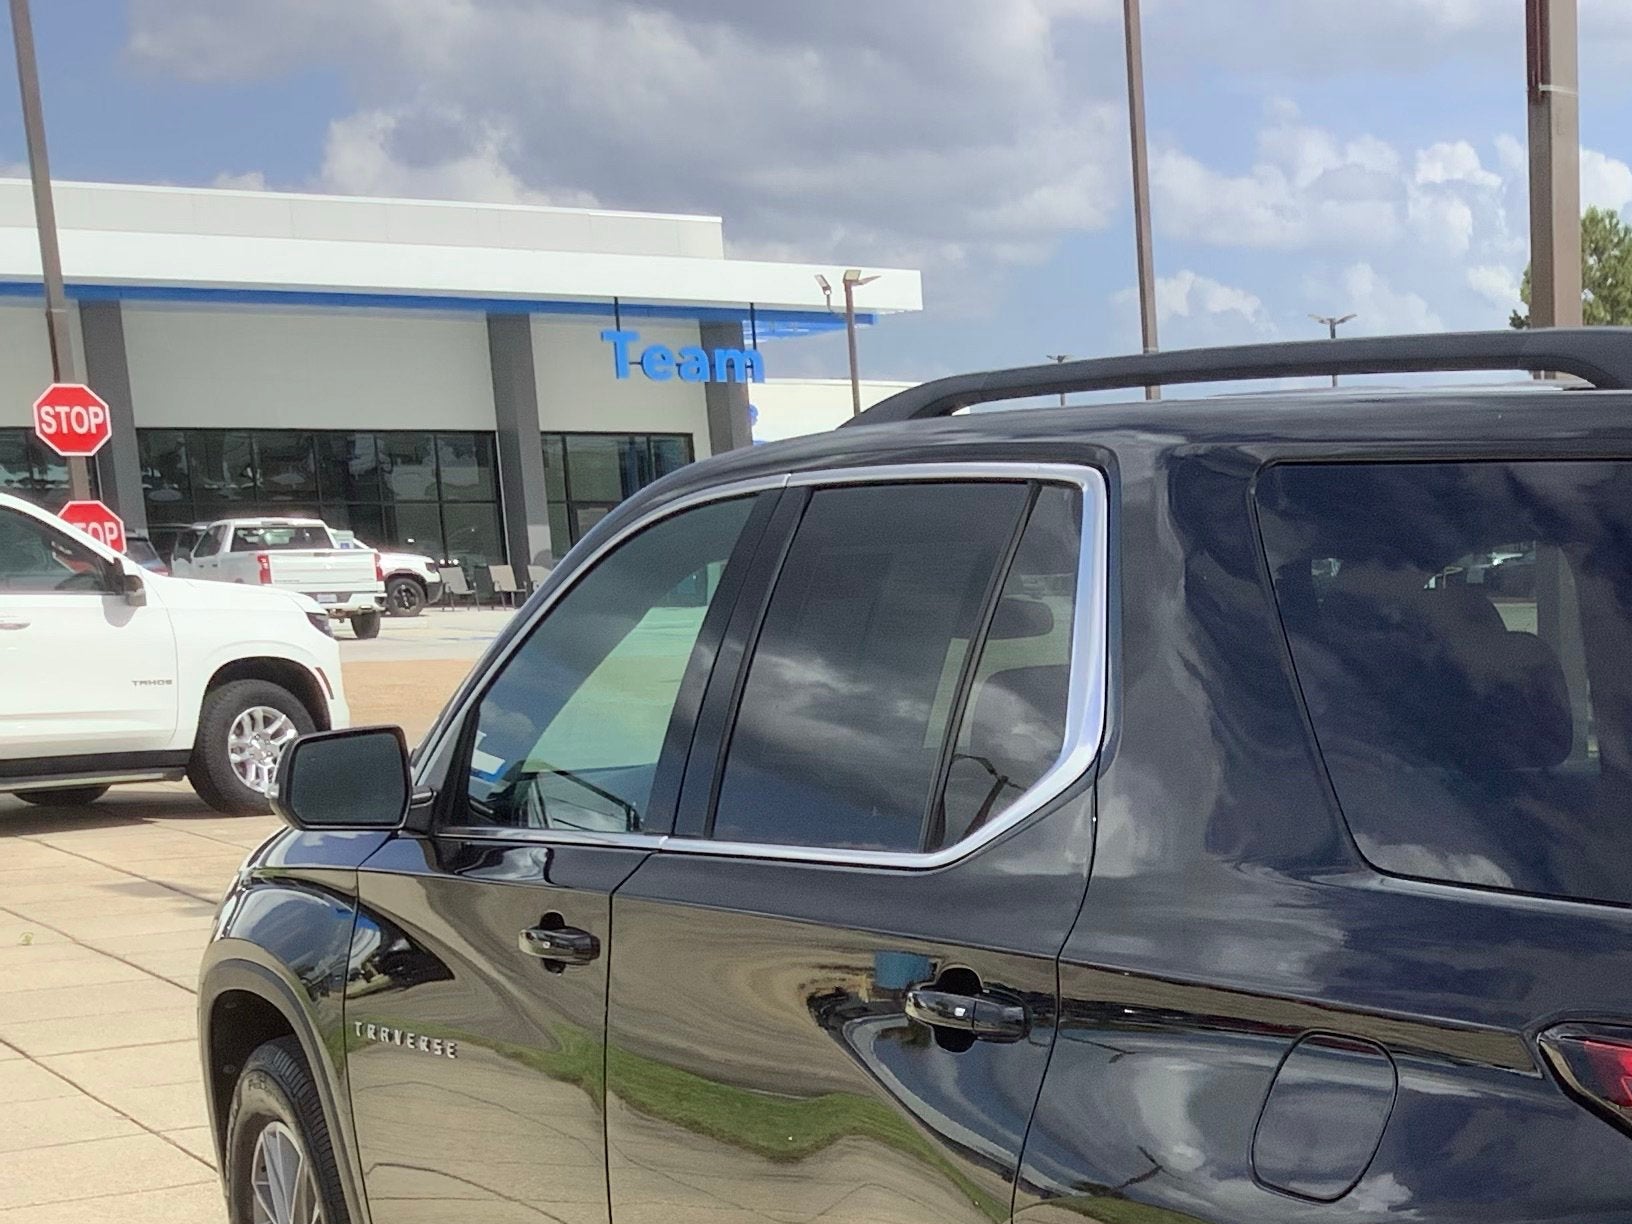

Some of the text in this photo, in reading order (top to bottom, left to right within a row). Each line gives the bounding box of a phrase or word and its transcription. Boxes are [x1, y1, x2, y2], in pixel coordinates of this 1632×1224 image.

[599, 329, 765, 383] Team
[40, 405, 104, 435] STOP
[71, 520, 120, 548] OP
[354, 1021, 459, 1059] TRAVERSE
